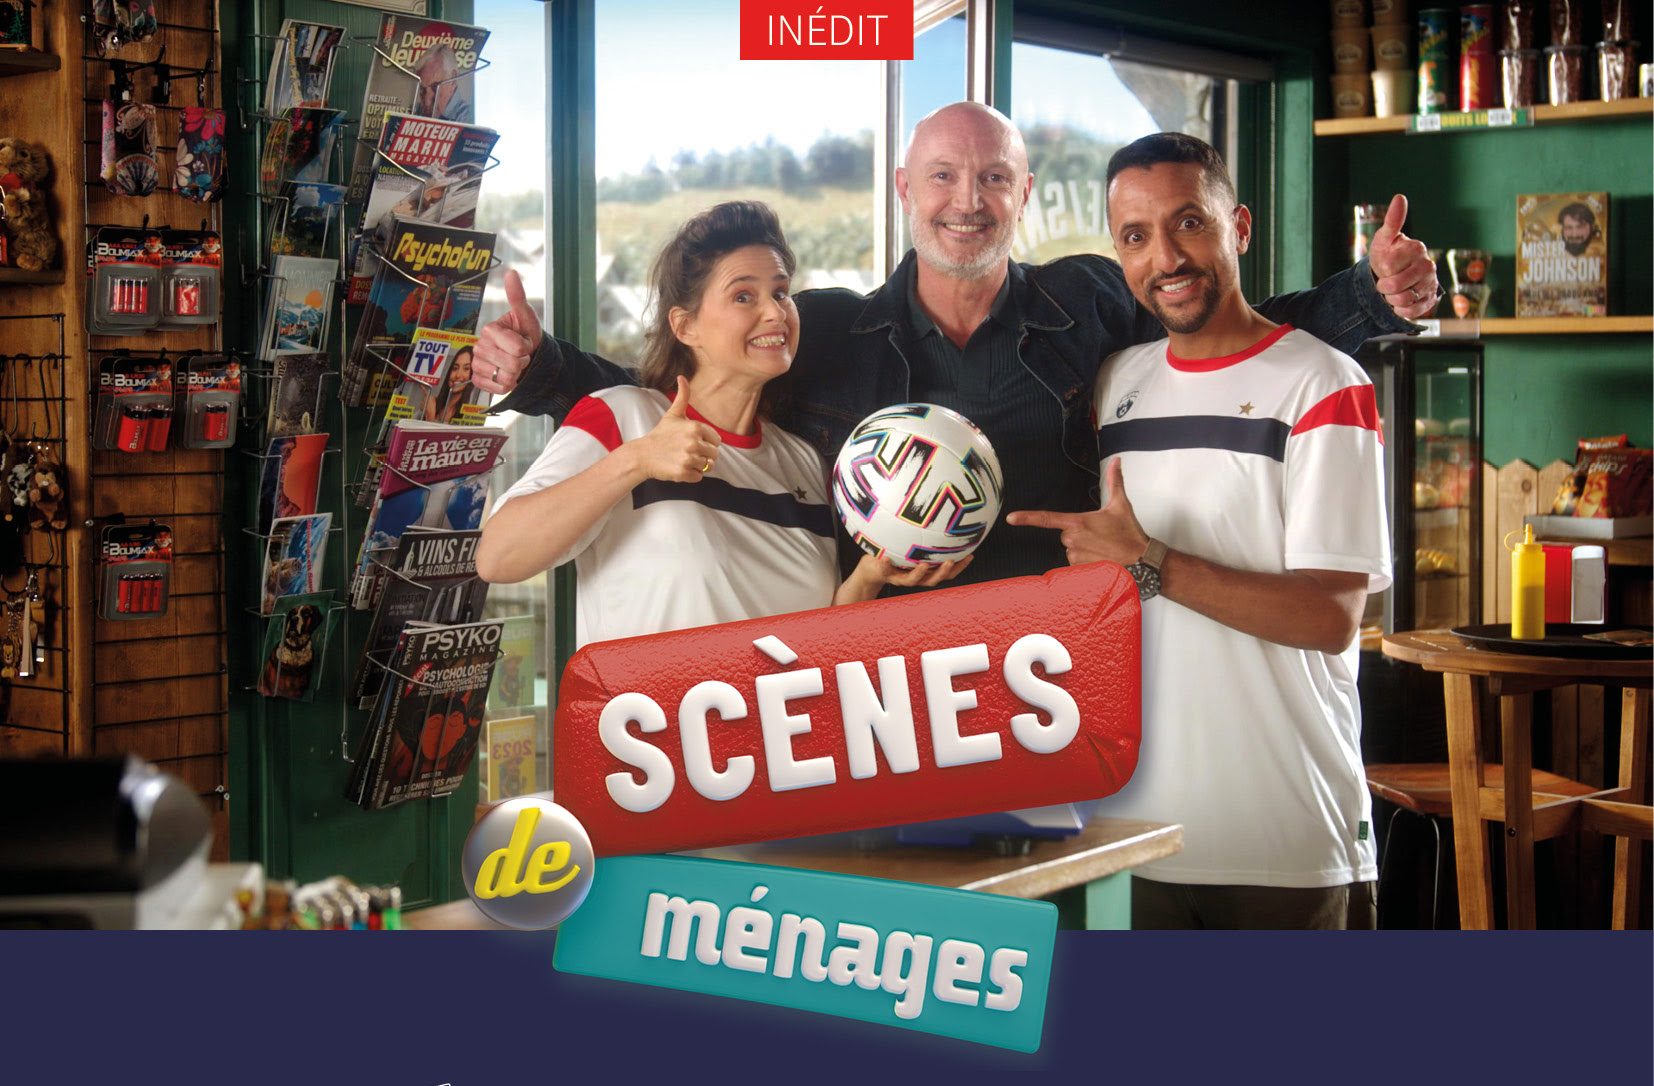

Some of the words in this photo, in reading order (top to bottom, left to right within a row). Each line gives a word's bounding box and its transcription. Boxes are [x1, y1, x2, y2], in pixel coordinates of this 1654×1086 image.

[382, 44, 477, 69] Jeuse
[401, 121, 459, 141] MOTEUR
[393, 136, 452, 157] MARIN
[1522, 240, 1565, 258] MISTER
[1523, 257, 1600, 282] JOHNSON
[419, 341, 449, 354] TOUT
[414, 352, 445, 375] TV
[414, 439, 438, 456] La
[440, 435, 465, 452] vie
[468, 437, 493, 449] en
[408, 448, 489, 472] mauve
[417, 538, 458, 565] VINS
[424, 563, 456, 576] ALCOOLS
[456, 562, 465, 573] DE
[422, 625, 500, 653] PSYKO
[420, 645, 496, 661] MAGAZINE
